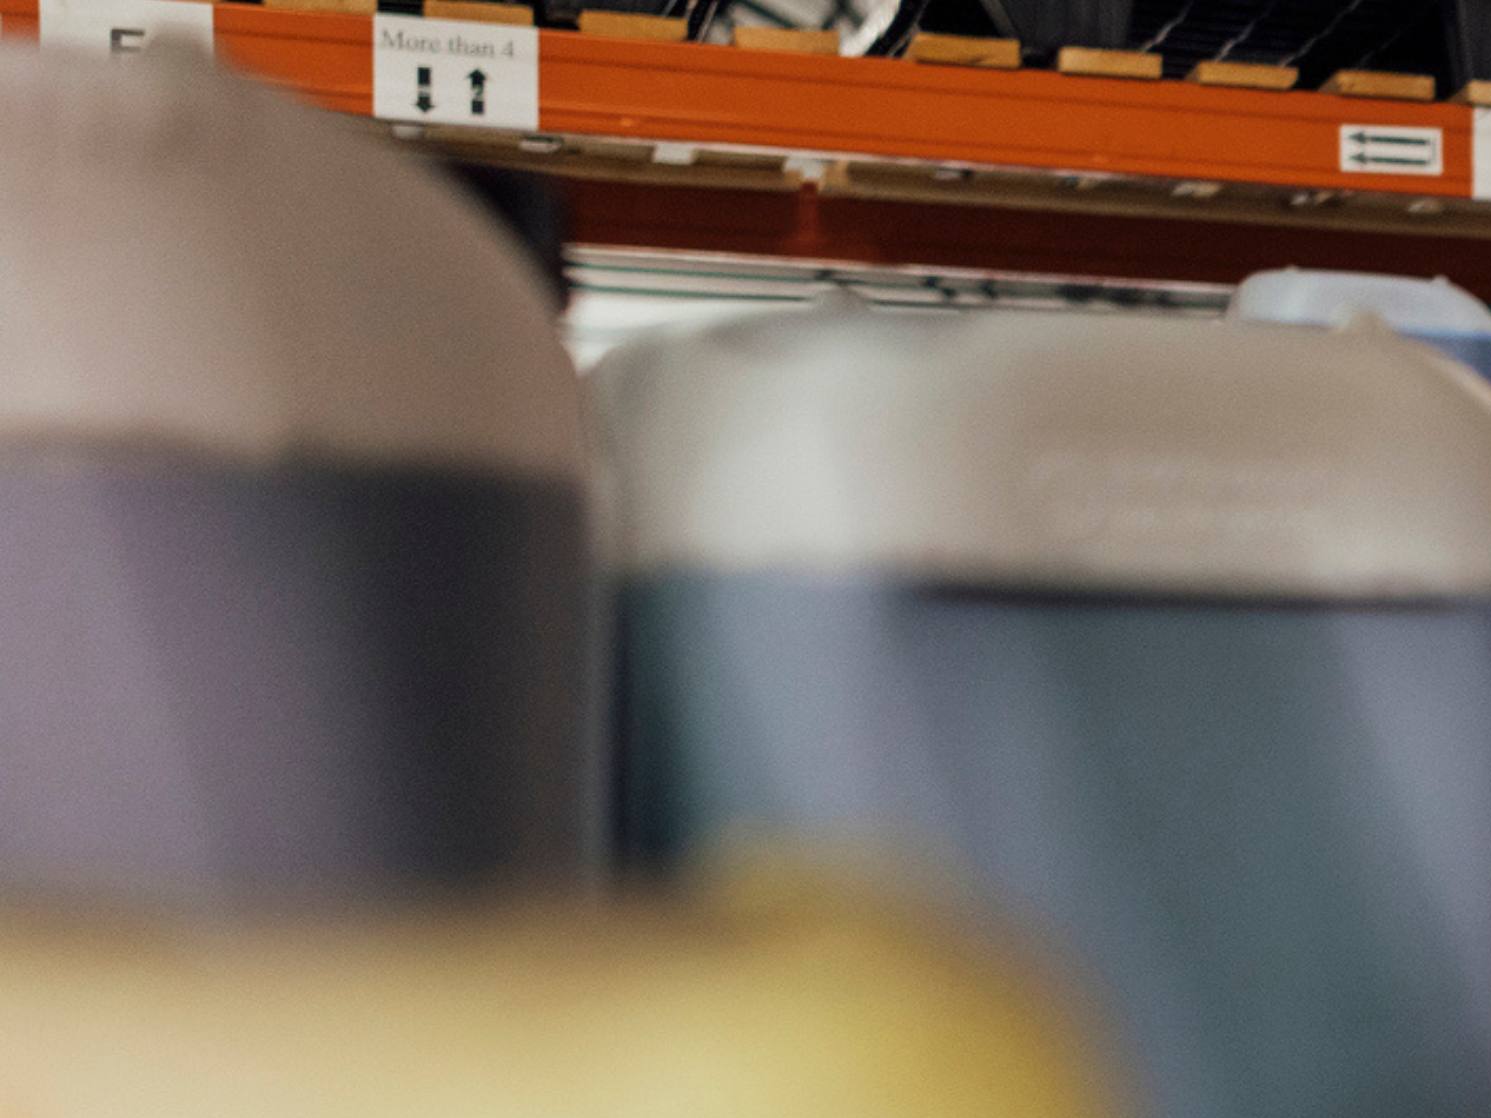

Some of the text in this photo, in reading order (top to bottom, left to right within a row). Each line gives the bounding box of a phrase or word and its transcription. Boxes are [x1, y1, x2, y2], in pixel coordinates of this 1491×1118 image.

[381, 29, 515, 58] More than 4
